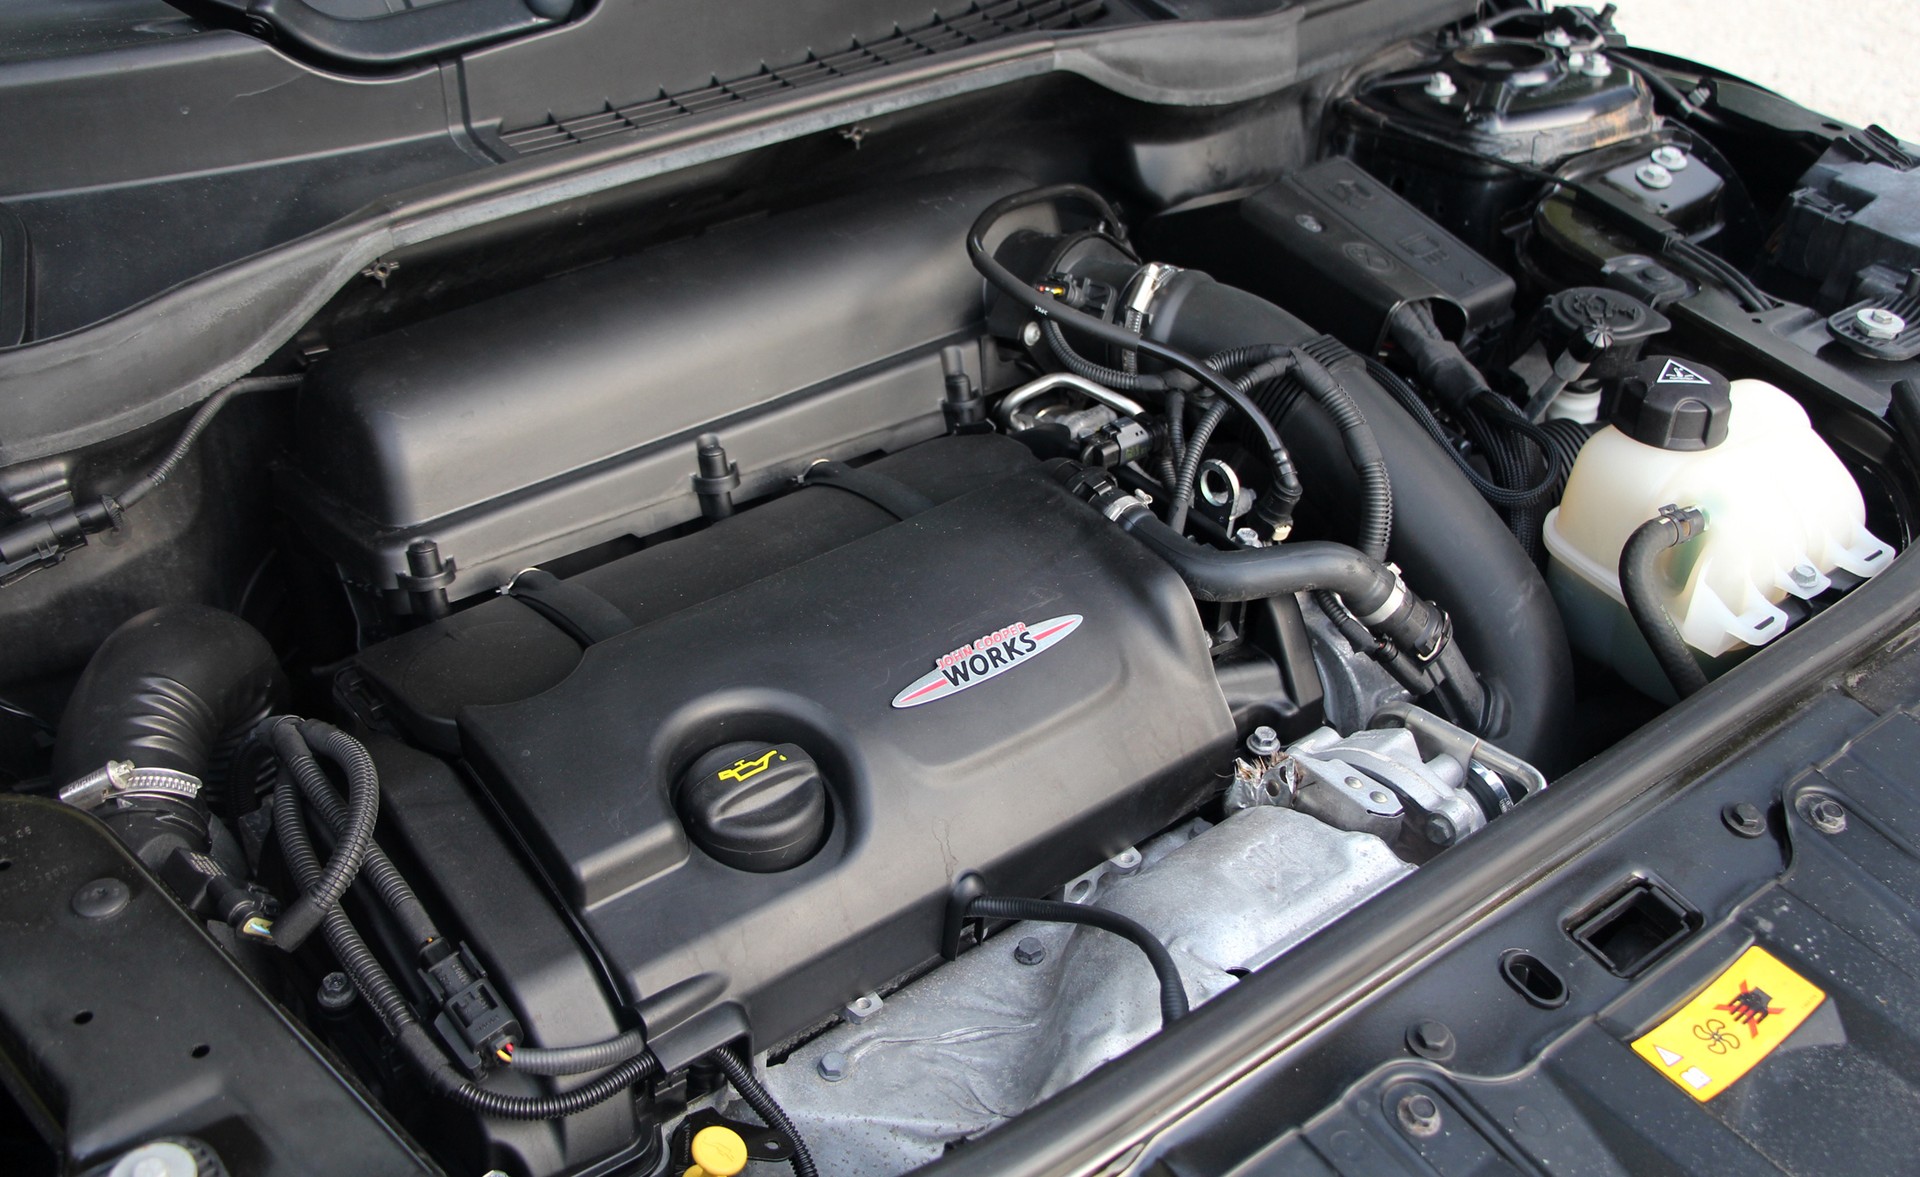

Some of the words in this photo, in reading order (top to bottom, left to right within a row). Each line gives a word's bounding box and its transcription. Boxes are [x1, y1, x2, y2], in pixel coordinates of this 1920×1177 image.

[938, 646, 973, 670] JOHN
[976, 622, 1027, 652] COOPER
[942, 631, 1037, 687] WORKS
